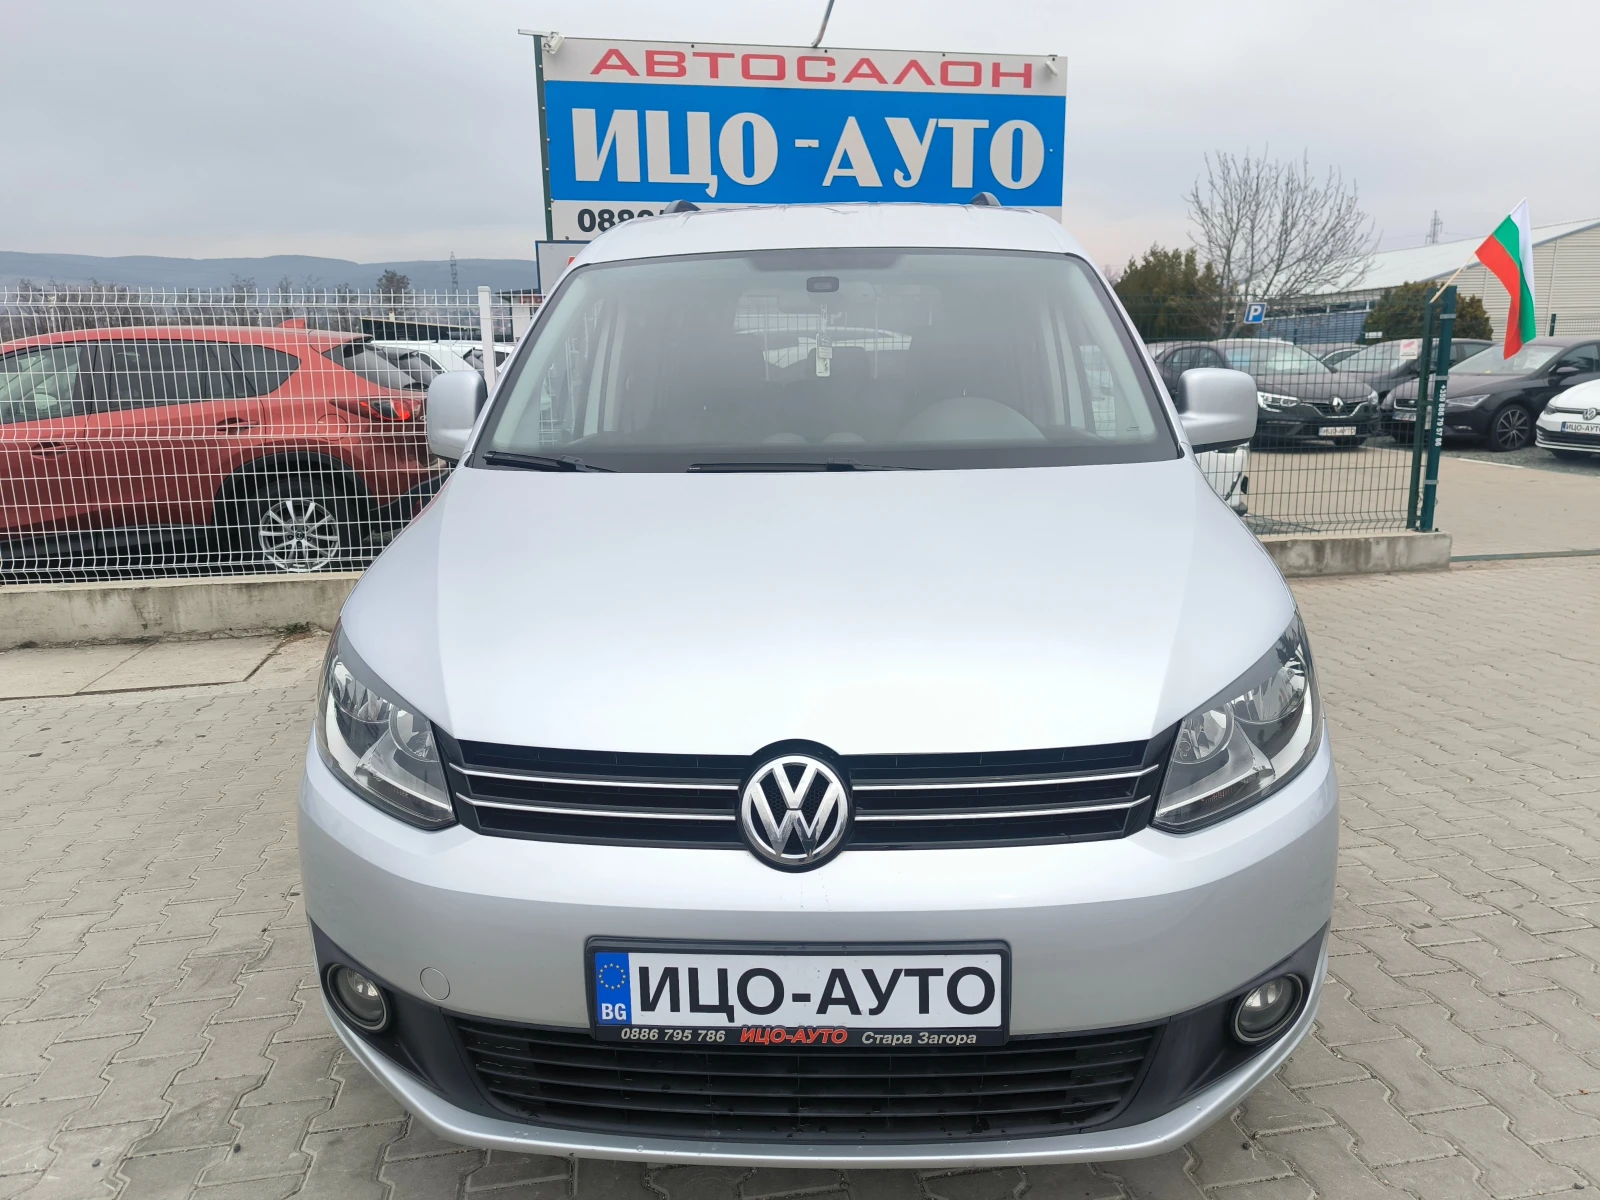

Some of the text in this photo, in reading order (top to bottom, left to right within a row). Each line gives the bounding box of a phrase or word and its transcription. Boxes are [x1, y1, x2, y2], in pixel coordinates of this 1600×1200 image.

[590, 48, 1033, 89] АВТОСАЛОН
[1248, 305, 1262, 321] P
[1439, 384, 1447, 402] +359
[1435, 427, 1443, 436] 57
[1566, 423, 1600, 433] ИЦО-АУТ
[638, 966, 996, 1024] ИЦО-АУТО
[601, 1003, 627, 1021] BG
[620, 1028, 726, 1043] 0886 795 786
[740, 1027, 848, 1045] ИЦО-АУТО
[861, 1032, 977, 1046] Стара Загора
